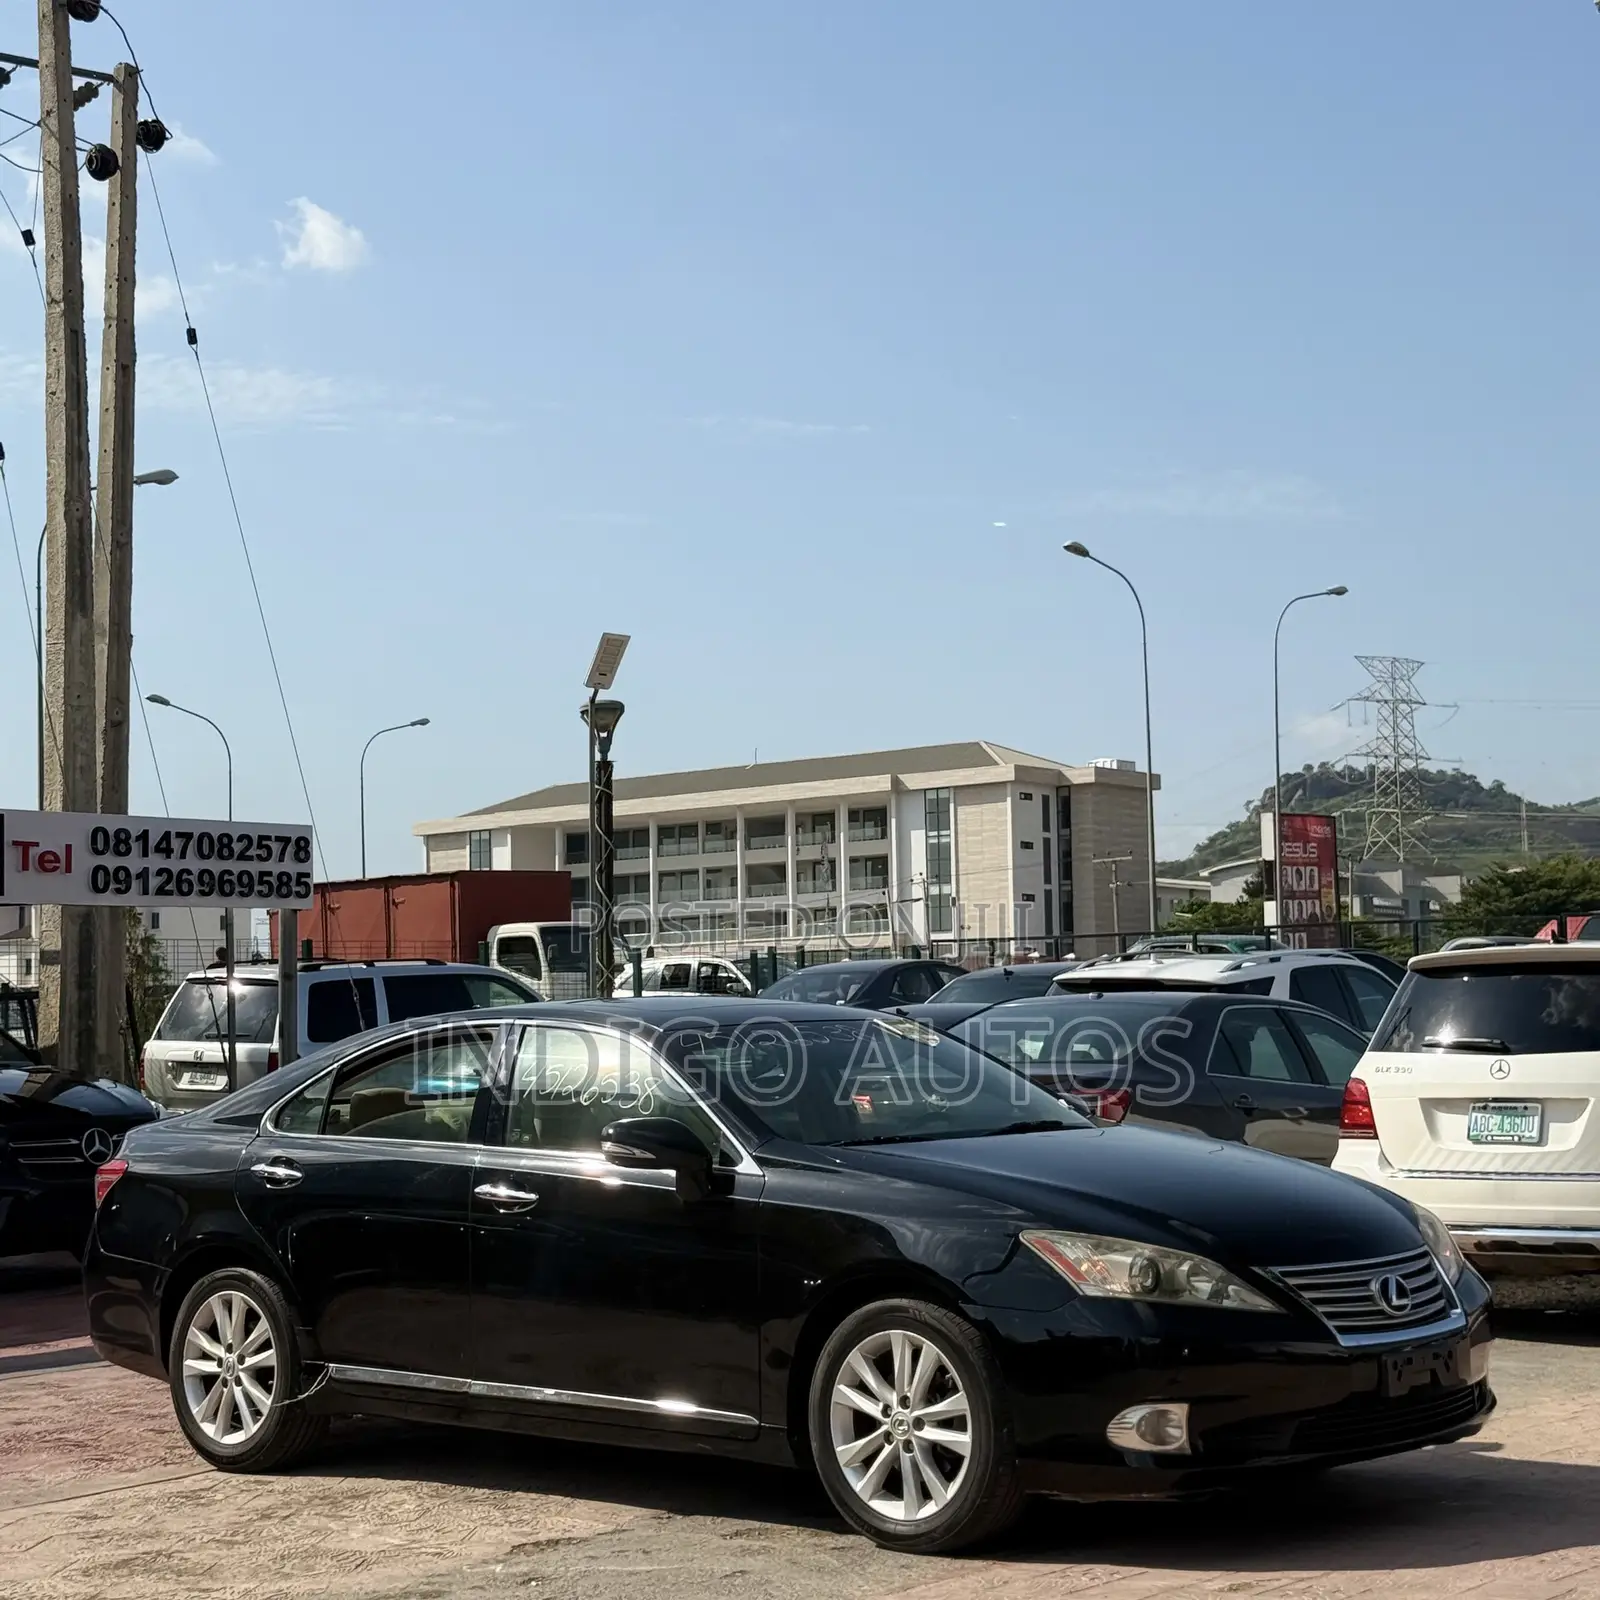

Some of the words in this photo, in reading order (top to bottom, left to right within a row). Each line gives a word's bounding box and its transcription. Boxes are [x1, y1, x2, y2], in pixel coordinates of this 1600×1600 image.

[12, 840, 72, 874] Tel
[89, 826, 311, 864] 08147082578
[1281, 840, 1318, 858] JESUS
[90, 864, 311, 899] 09126969585
